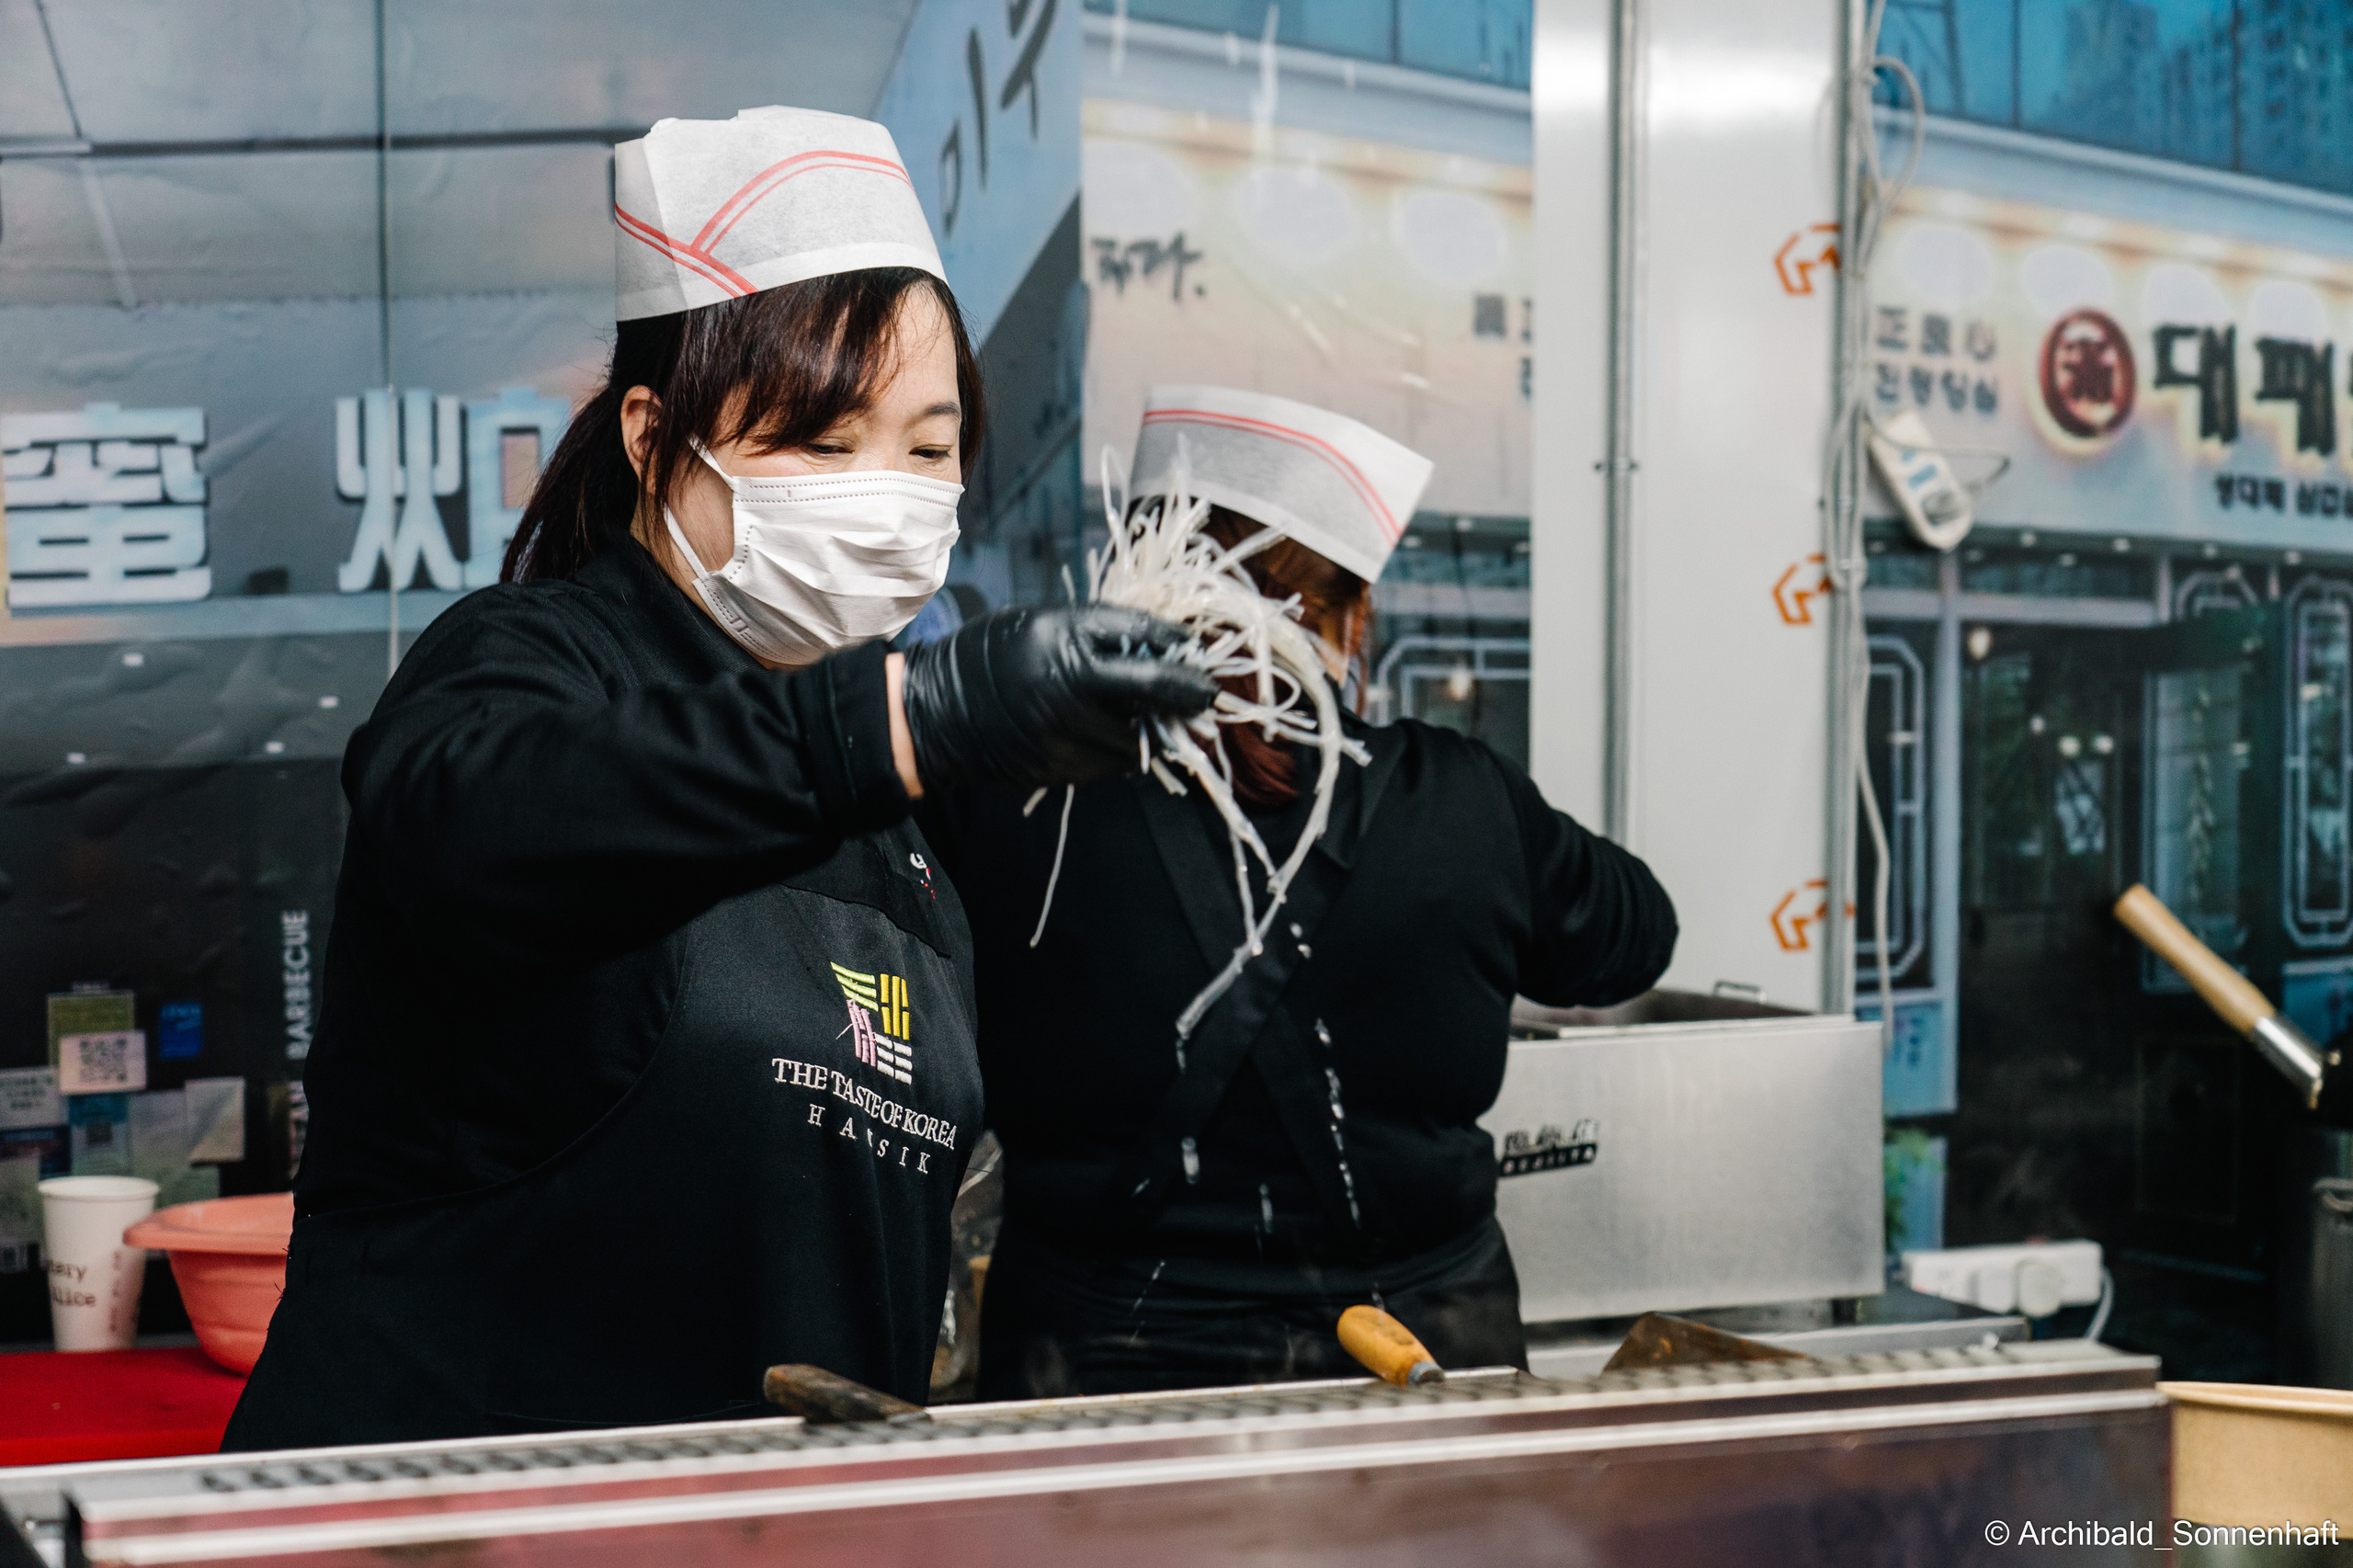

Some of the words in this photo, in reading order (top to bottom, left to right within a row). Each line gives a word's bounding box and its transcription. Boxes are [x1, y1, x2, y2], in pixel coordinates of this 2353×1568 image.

[2153, 320, 2353, 458] 대패
[771, 1058, 828, 1090] THE
[831, 1070, 882, 1119] TASTE
[880, 1100, 904, 1128] OF
[902, 1108, 958, 1150] KOREA
